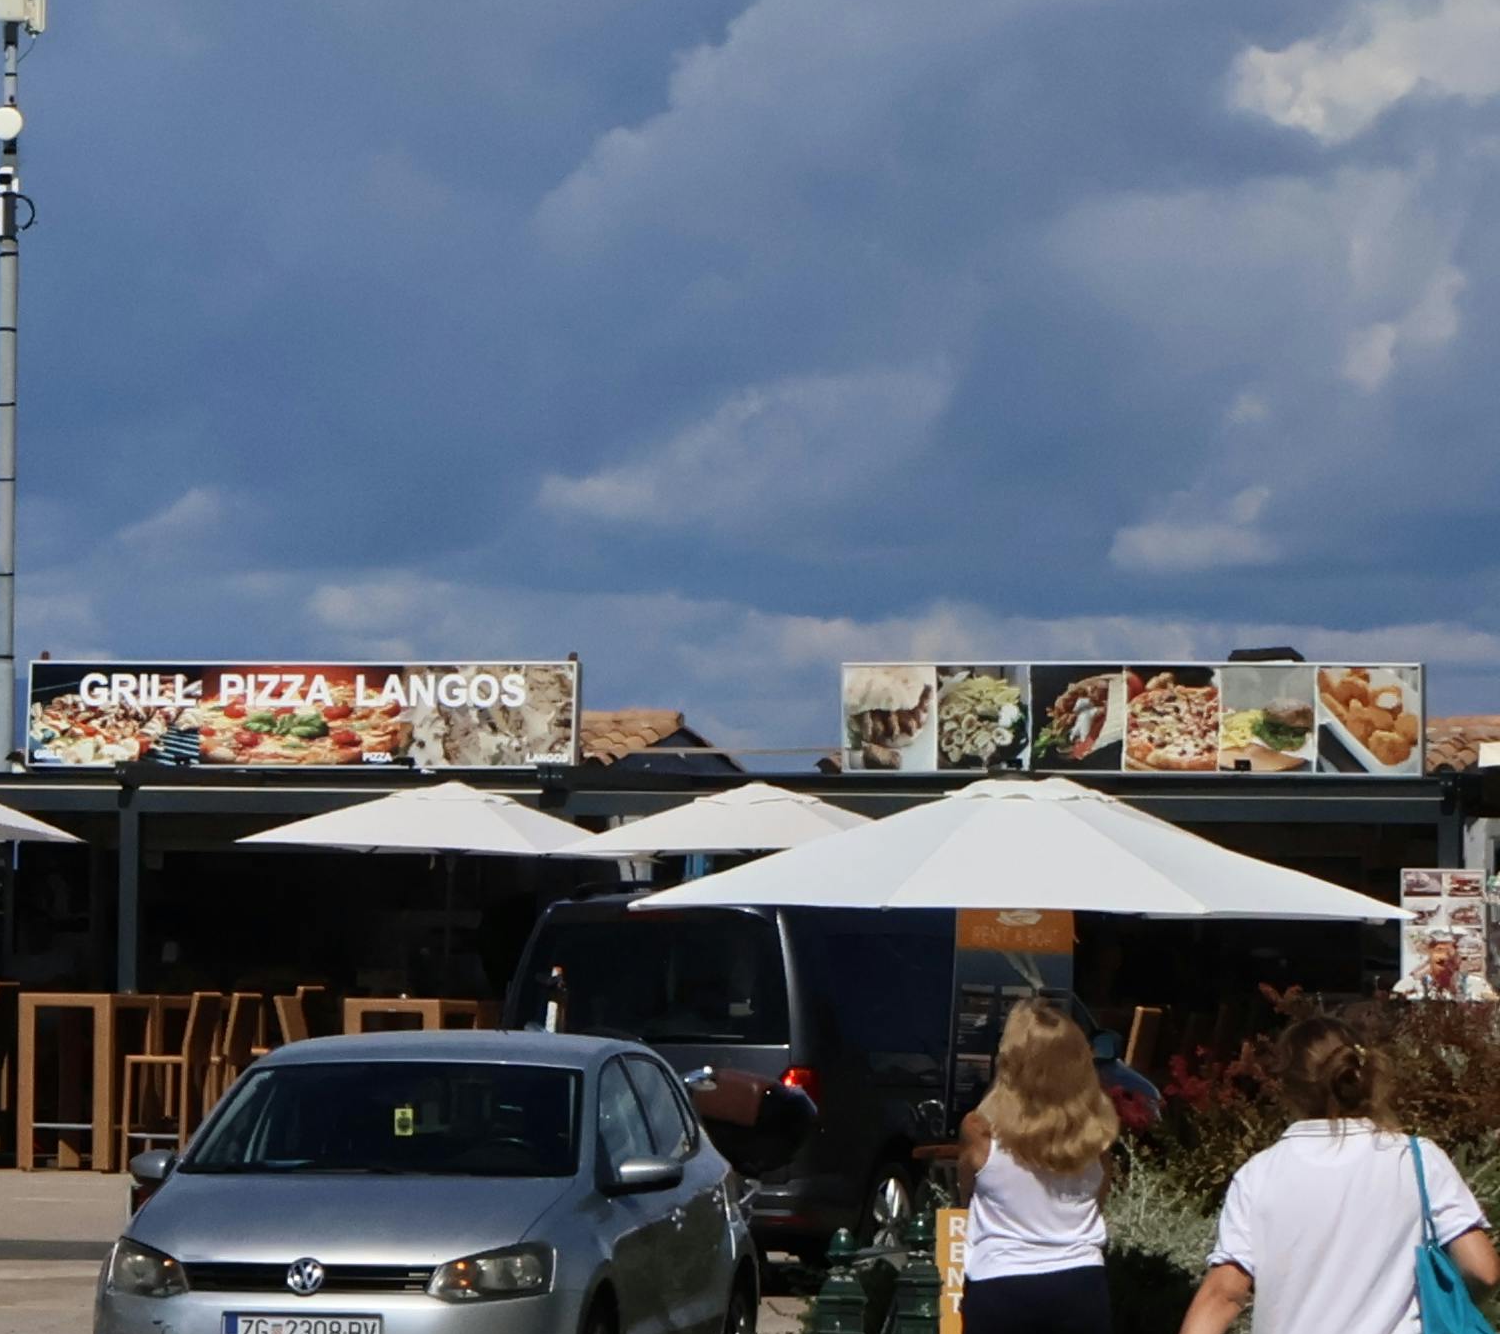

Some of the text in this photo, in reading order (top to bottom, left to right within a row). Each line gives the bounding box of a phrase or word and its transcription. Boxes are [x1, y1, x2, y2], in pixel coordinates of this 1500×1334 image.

[79, 672, 527, 709] GRILL PIZZA LANGOS
[362, 751, 393, 763] PIZZA
[946, 1216, 966, 1313] RENT
